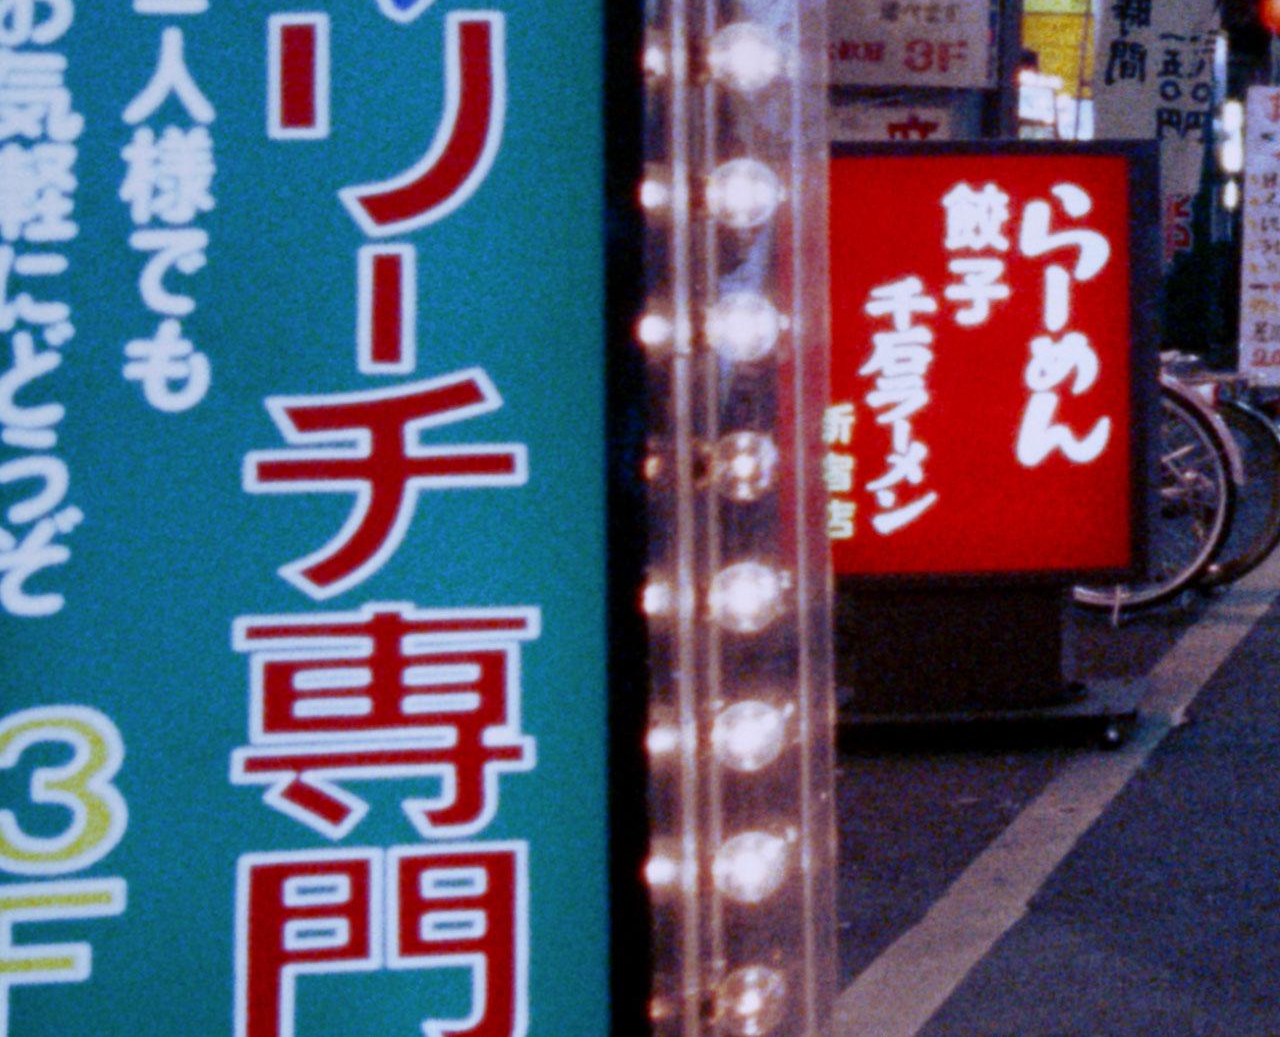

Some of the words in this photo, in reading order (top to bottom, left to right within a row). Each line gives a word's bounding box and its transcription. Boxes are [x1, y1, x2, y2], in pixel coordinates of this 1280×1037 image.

[941, 179, 1010, 327] 餃子
[1014, 182, 1112, 469] らーめん
